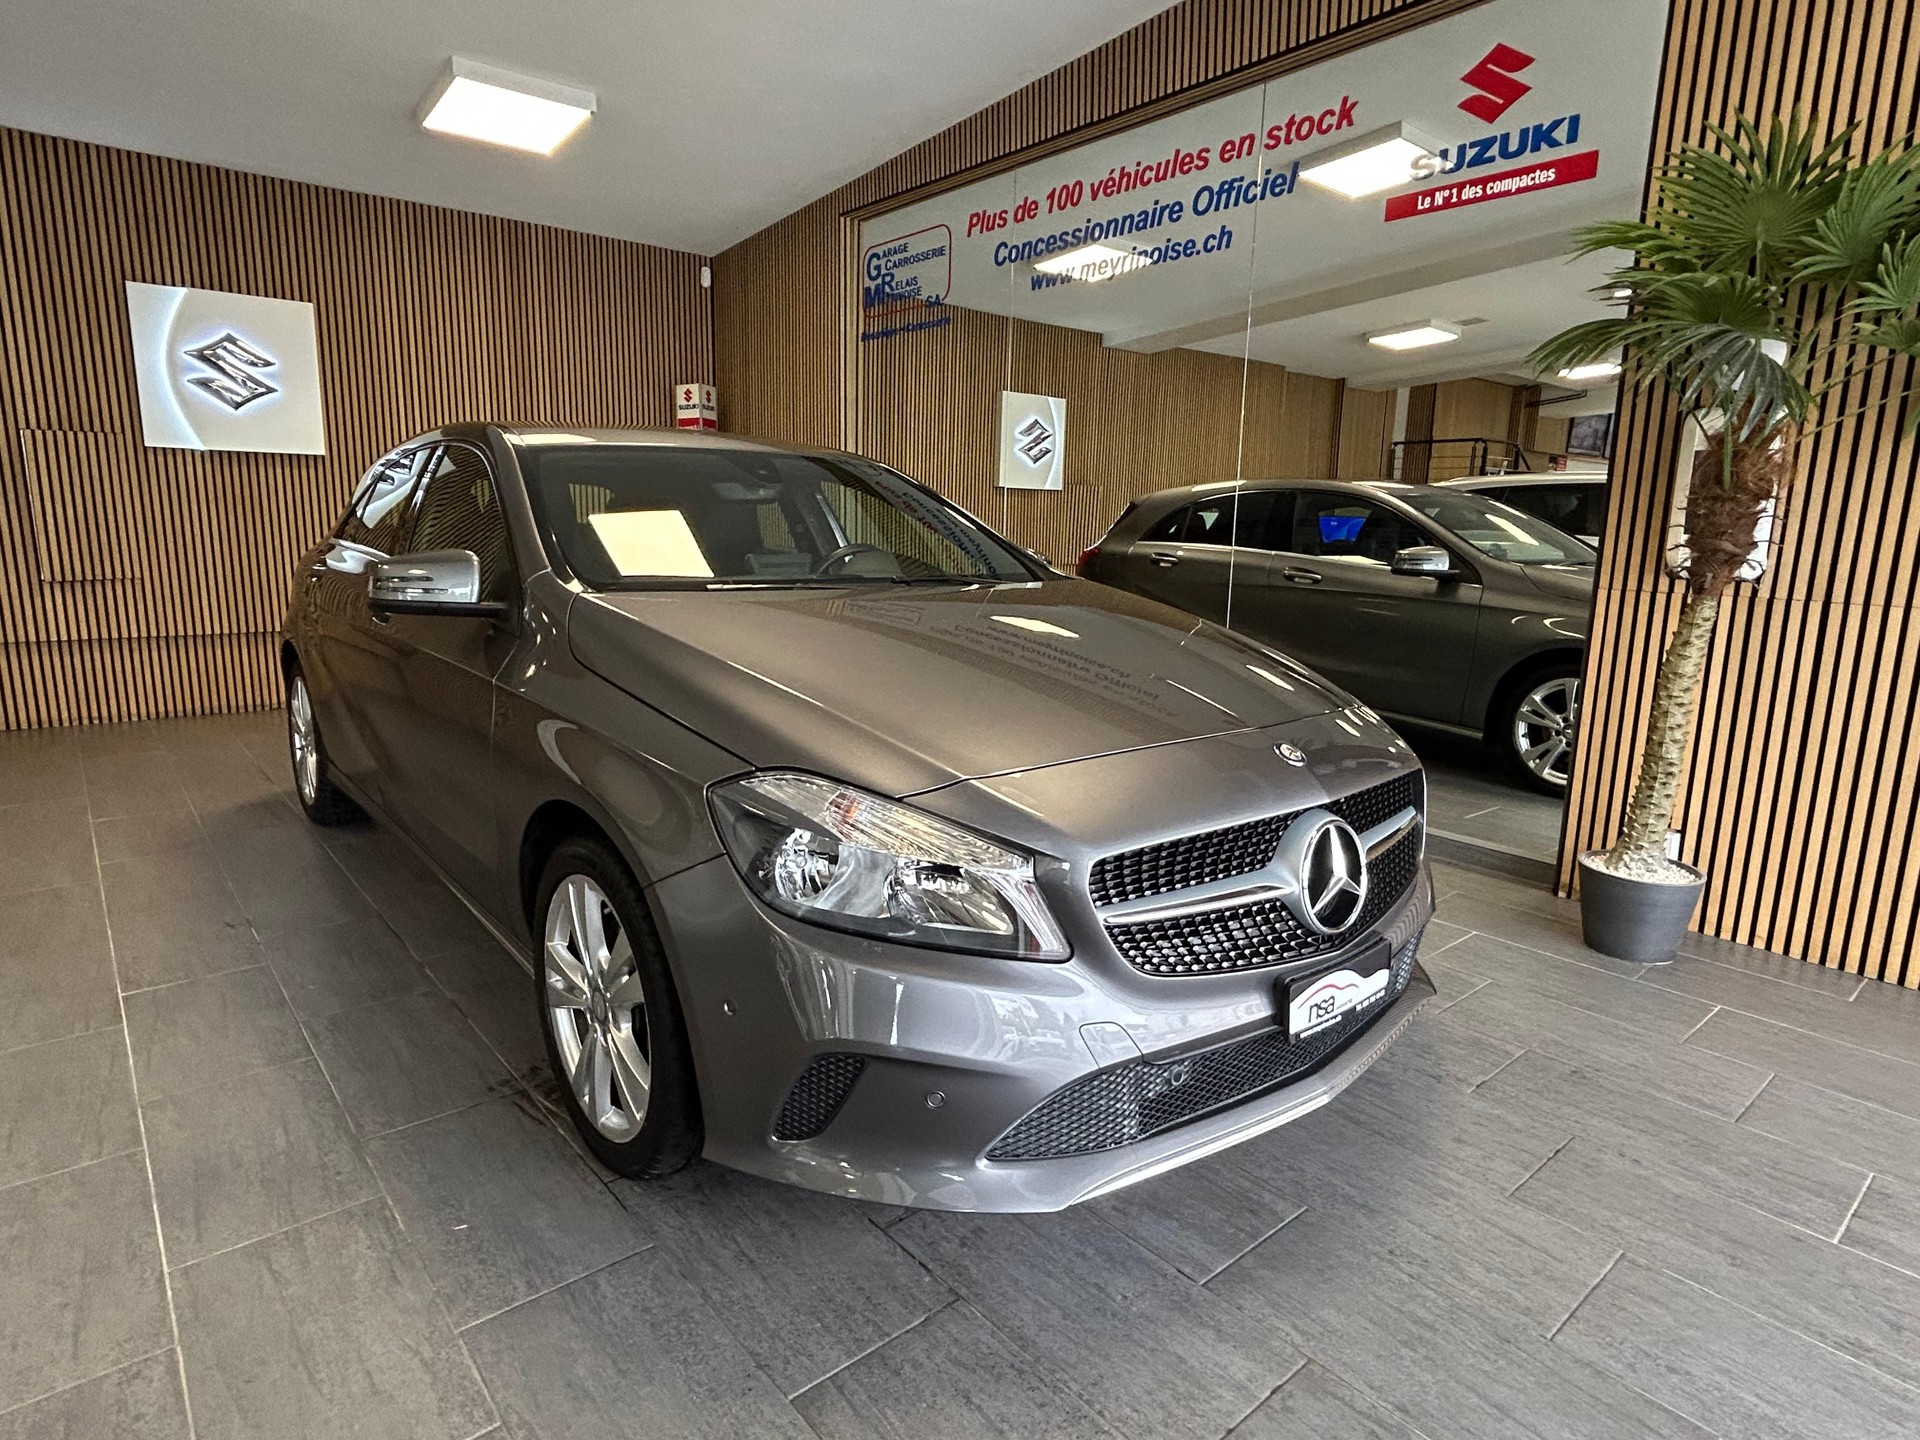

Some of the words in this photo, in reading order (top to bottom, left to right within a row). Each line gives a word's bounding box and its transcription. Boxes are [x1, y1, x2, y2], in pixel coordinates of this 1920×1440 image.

[966, 209, 1008, 238] Plus
[1013, 197, 1039, 224] de
[1046, 180, 1084, 214] 100
[1090, 147, 1210, 201] véhicules
[1218, 133, 1256, 164] en
[1263, 95, 1359, 151] stock
[1410, 113, 1581, 181] SUZUKI
[994, 200, 1184, 267] Concessionnaire
[1192, 160, 1300, 217] Officiel
[1417, 195, 1432, 210] Le
[1461, 184, 1483, 201] des
[1486, 167, 1556, 194] compactes
[881, 271, 919, 292] RELAIS
[884, 245, 947, 271] CARROSSERIE
